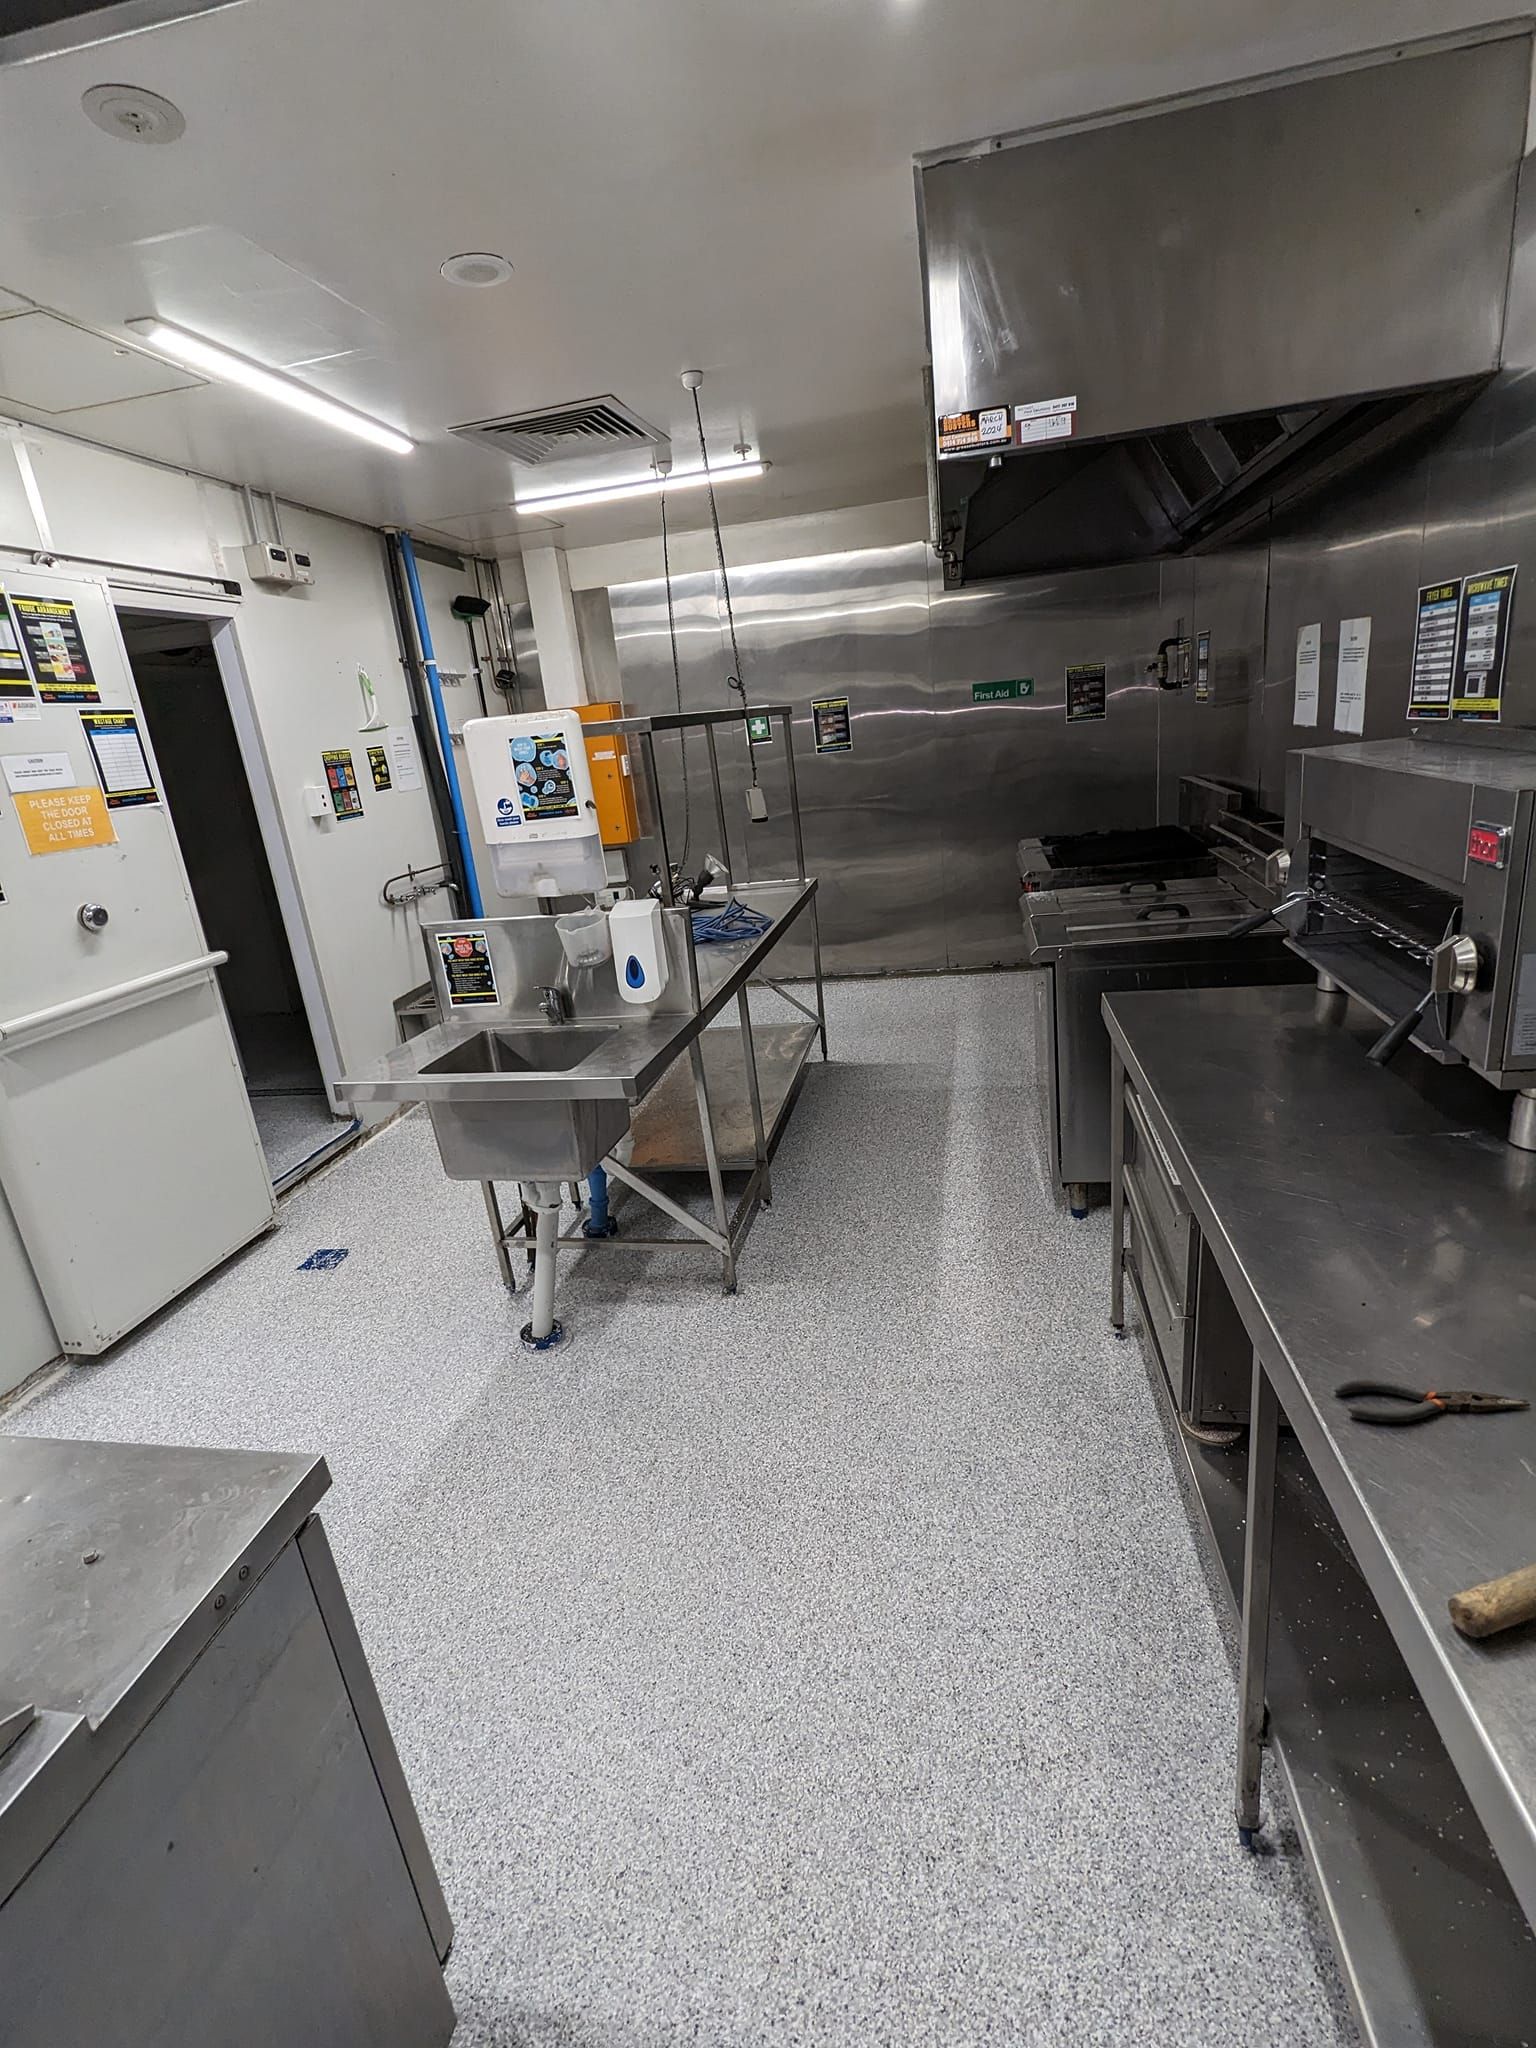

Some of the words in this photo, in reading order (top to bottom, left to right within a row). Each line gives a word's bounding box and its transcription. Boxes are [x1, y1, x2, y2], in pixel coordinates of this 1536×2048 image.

[974, 691, 993, 700] First
[995, 689, 1009, 698] Aid
[29, 796, 67, 809] PLEASE
[68, 794, 92, 804] KEEP
[40, 810, 61, 820] THE
[62, 808, 88, 818] DOOR
[42, 818, 81, 832] CLOSED
[82, 816, 93, 826] AT
[49, 831, 66, 842] ALL
[67, 828, 95, 839] TIMES
